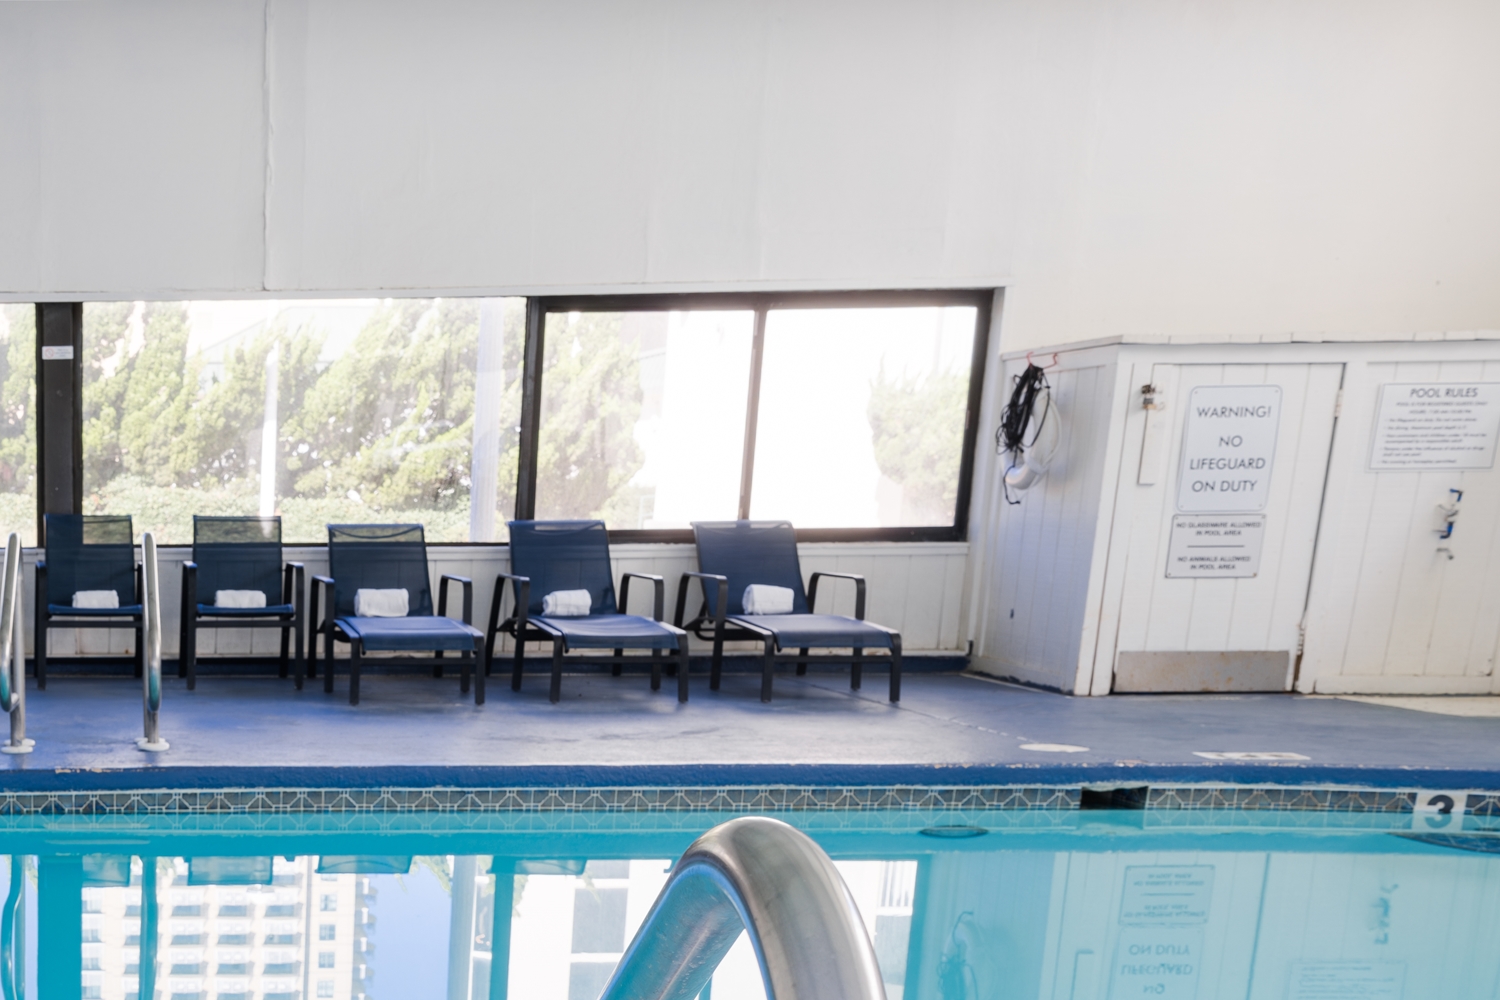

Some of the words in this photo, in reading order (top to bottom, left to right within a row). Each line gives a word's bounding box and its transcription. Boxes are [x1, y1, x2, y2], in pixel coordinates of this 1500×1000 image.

[1410, 388, 1441, 398] POOL
[1445, 387, 1479, 398] RULES
[1196, 405, 1272, 418] WARNING!
[1218, 435, 1243, 447] NO
[1189, 457, 1266, 470] LIFEGUARD
[1191, 480, 1216, 492] ON
[1220, 479, 1258, 492] DUTY
